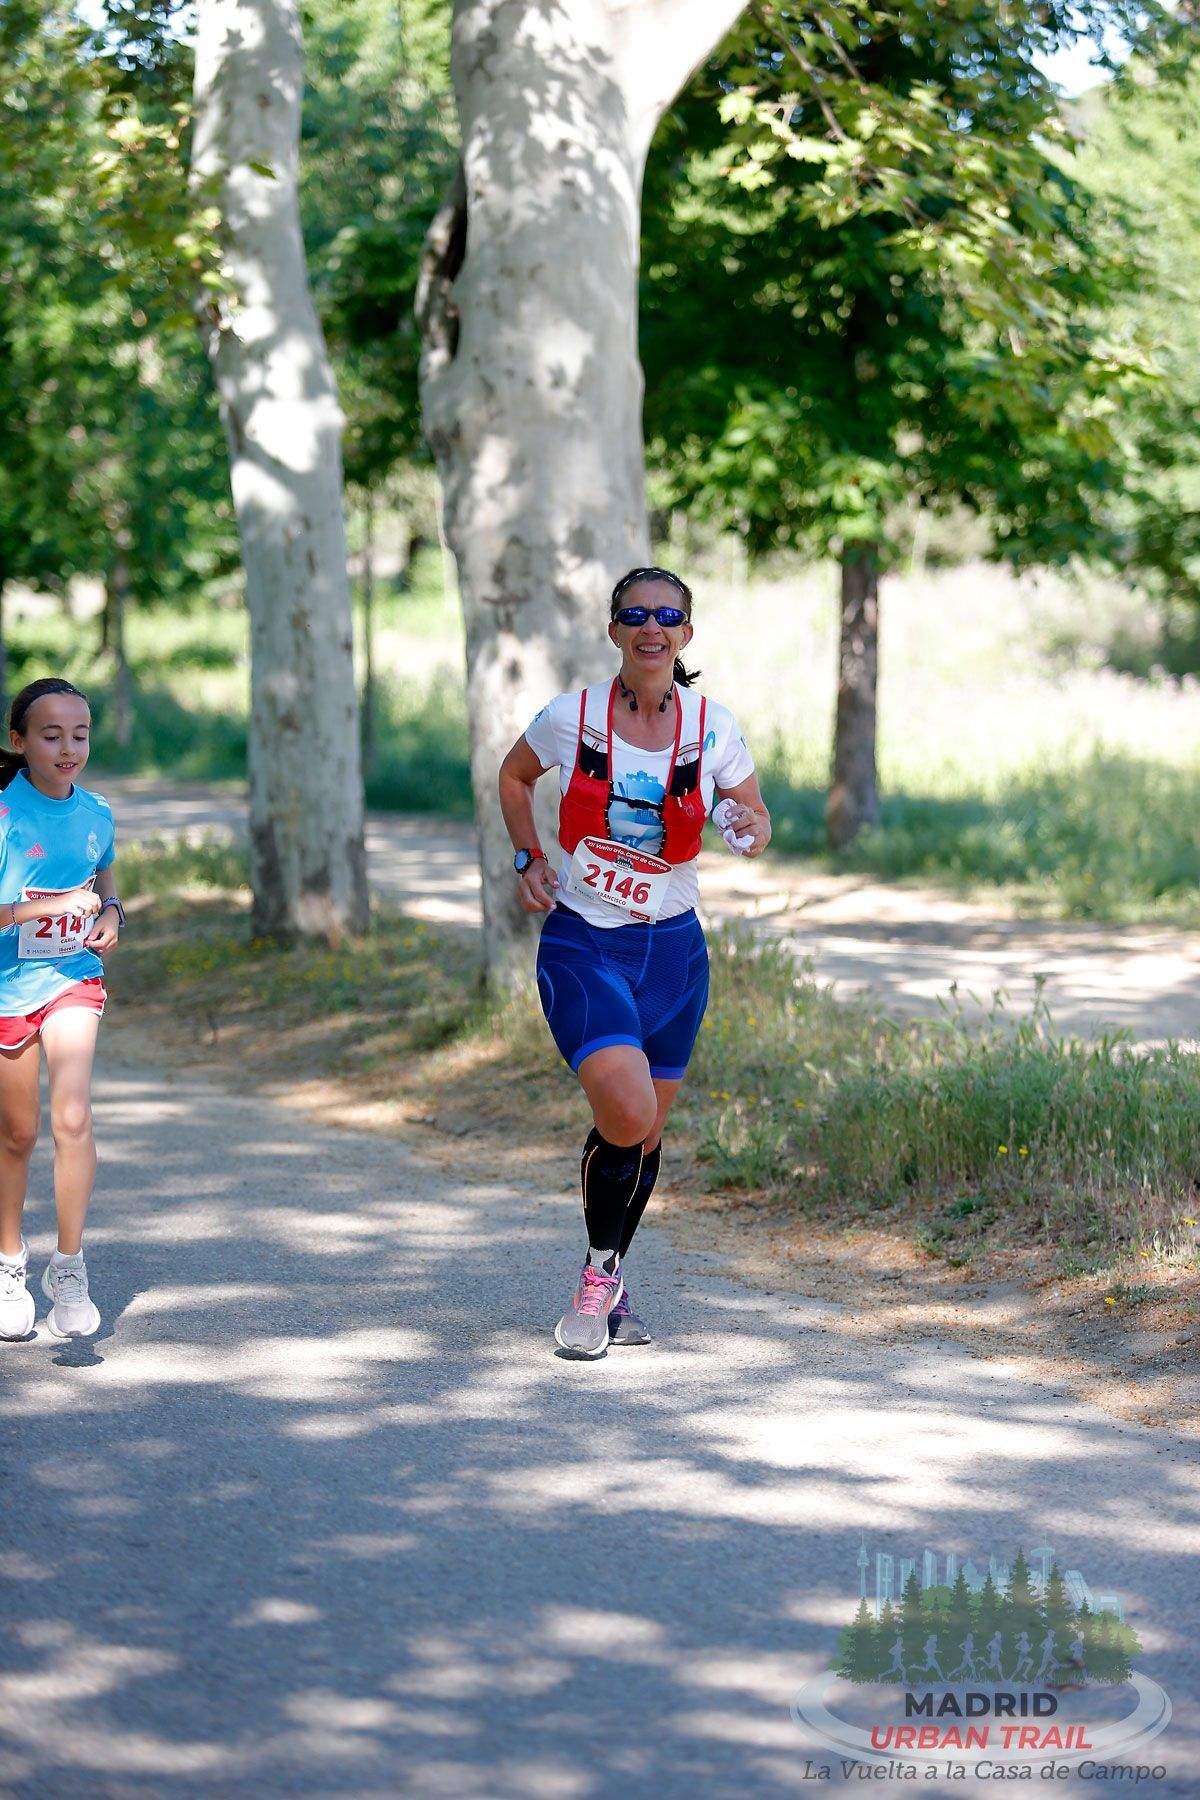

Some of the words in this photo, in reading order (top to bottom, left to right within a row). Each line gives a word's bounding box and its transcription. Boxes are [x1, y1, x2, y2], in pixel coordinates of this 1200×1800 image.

[595, 843, 613, 852] Vuelta
[625, 850, 640, 861] Casa
[647, 860, 668, 872] Campo
[583, 863, 652, 905] 2146
[35, 914, 85, 939] 214
